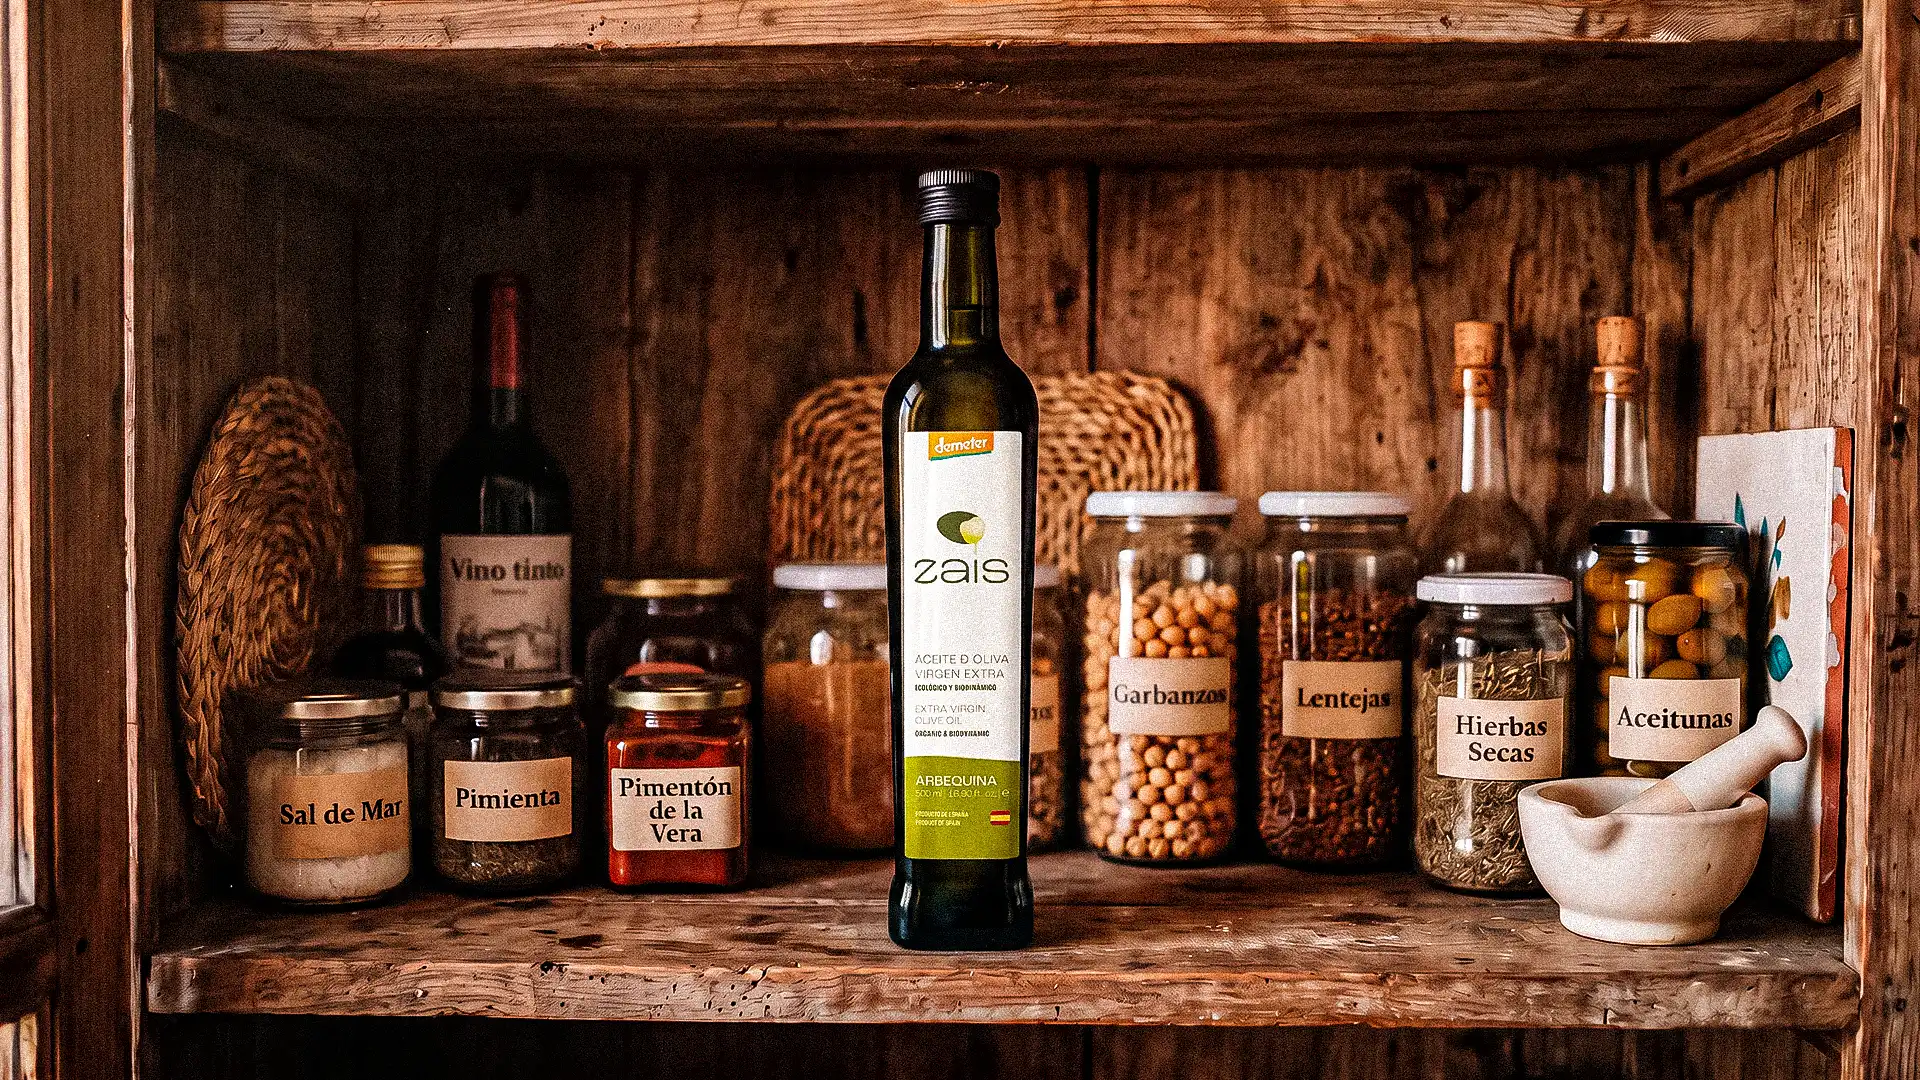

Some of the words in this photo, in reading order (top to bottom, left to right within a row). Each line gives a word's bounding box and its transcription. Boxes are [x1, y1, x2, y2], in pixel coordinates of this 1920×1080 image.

[934, 436, 988, 453] demeter
[451, 556, 507, 581] Vino
[513, 557, 565, 581] tinto
[914, 558, 1010, 584] zais
[914, 654, 957, 664] ACEITE
[973, 654, 1009, 664] OLIVA
[914, 669, 960, 679] VIRGEN
[964, 669, 1005, 679] EXTRA
[1114, 683, 1228, 705] Garbanzos
[1297, 687, 1391, 714] Lentejas
[914, 704, 948, 713] EXTRA
[950, 704, 986, 713] VIRGIN
[1616, 705, 1733, 729] Aceitunas
[914, 716, 944, 725] OLIVE
[945, 716, 963, 725] OIL
[1456, 714, 1548, 737] Hierbas
[1468, 741, 1535, 763] Secas
[618, 775, 733, 797] Pimentón
[915, 775, 998, 787] ARBEQUINA
[455, 787, 561, 809] Pimienta
[280, 803, 318, 825] Sal
[323, 803, 356, 825] de
[361, 798, 403, 822] Mar
[649, 800, 677, 820] de
[683, 800, 704, 820] la
[649, 823, 704, 844] Vera
